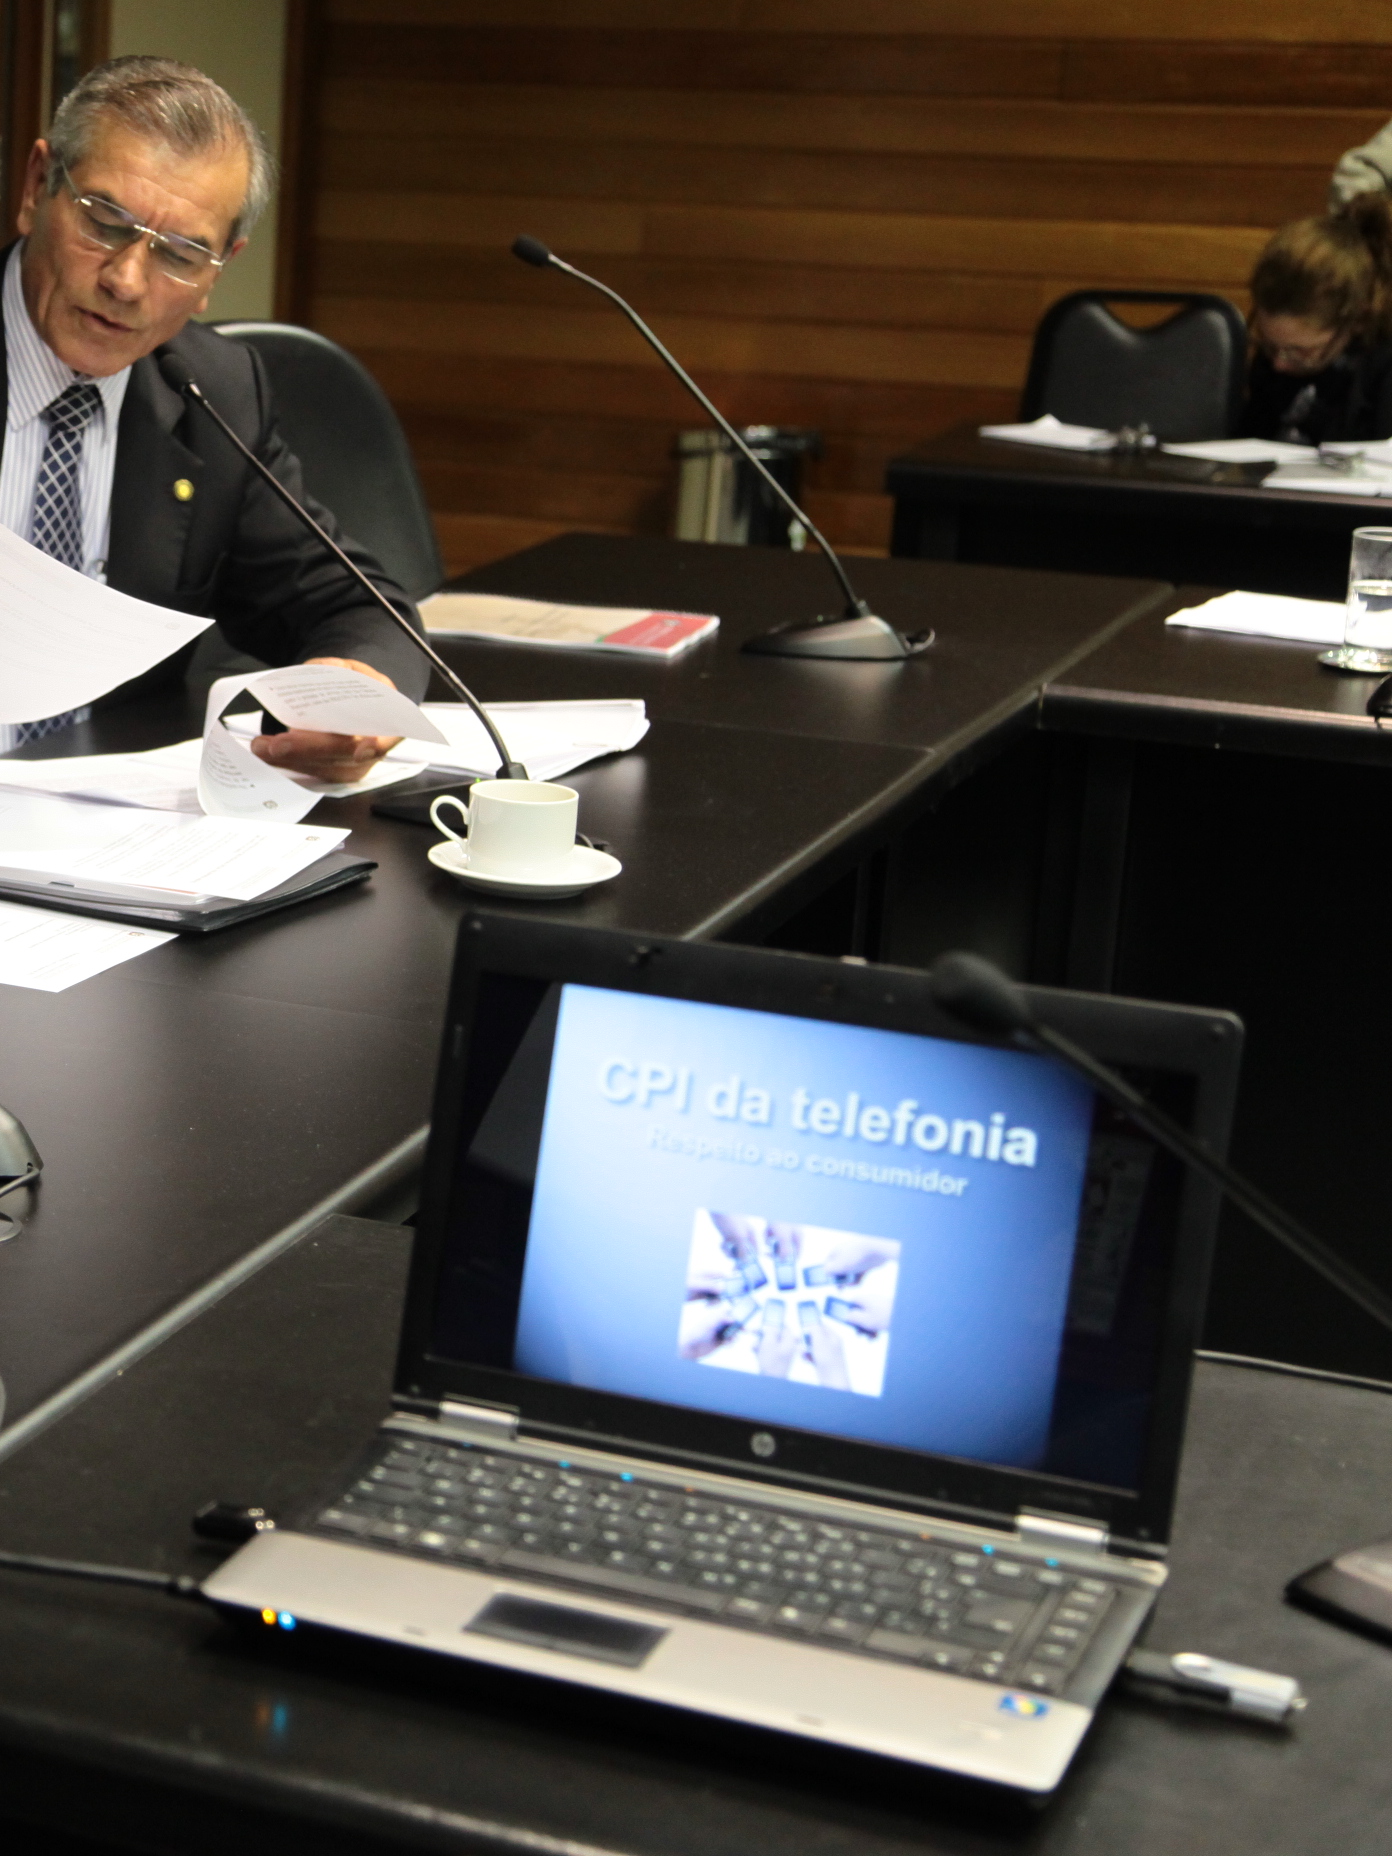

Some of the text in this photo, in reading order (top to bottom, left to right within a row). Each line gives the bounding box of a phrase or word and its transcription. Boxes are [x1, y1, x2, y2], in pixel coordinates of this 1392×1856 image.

[599, 1056, 1038, 1167] CPI da telefonia
[646, 1124, 970, 1197] Respeito ao consumidor
